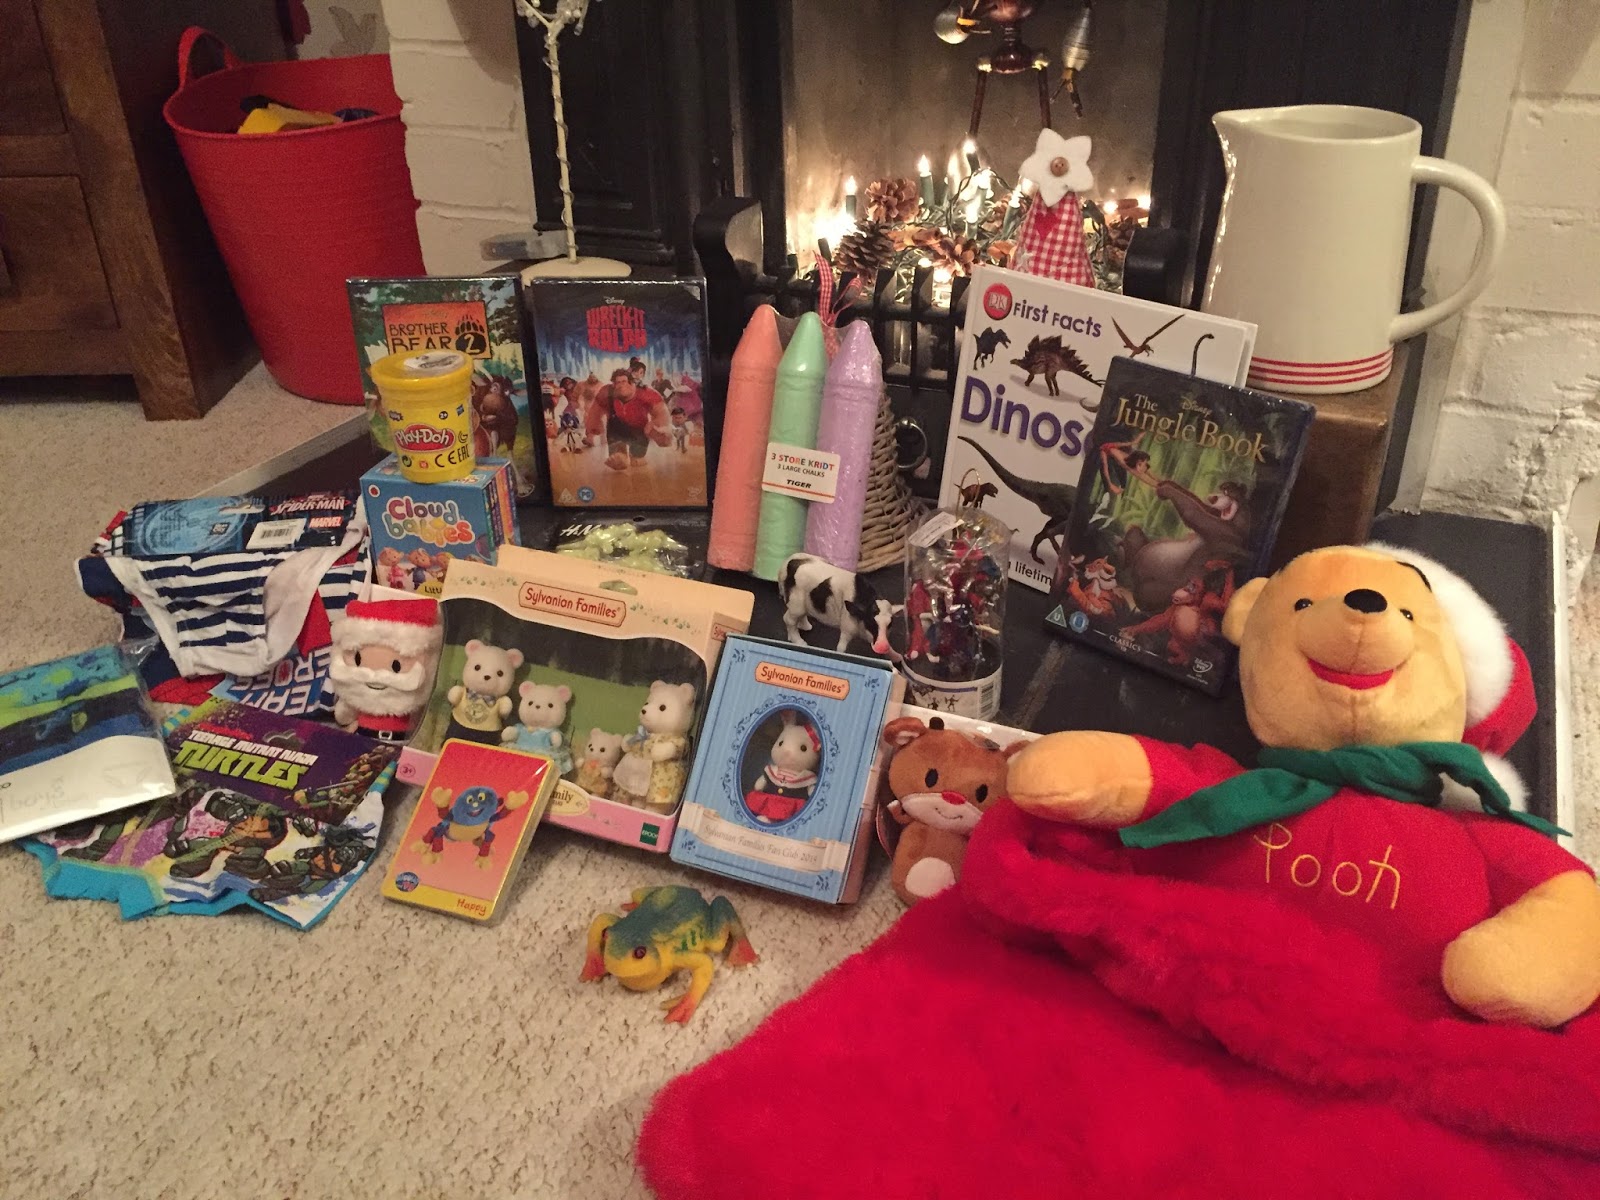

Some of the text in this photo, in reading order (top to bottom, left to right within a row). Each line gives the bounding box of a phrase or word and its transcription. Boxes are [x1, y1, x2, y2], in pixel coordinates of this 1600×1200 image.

[988, 292, 1009, 311] DK
[586, 305, 646, 328] WRECK-IT
[1013, 299, 1102, 338] First Facts
[389, 322, 449, 337] BROTHER
[464, 333, 481, 354] 2
[587, 328, 648, 353] RALPH
[1134, 393, 1159, 412] The
[395, 428, 450, 446] Play-Doh
[1110, 397, 1269, 464] Jungle Book
[771, 453, 835, 471] 3 STORE KRIDT
[782, 465, 801, 474] LARGE
[802, 468, 825, 478] CHALKS
[786, 479, 812, 489] TIGER
[270, 497, 345, 516] SPIDER-MAN
[387, 496, 459, 526] Cloud
[309, 516, 343, 529] MARVEL
[382, 512, 476, 548] babies
[1014, 561, 1052, 586] lifetim
[424, 585, 442, 595] Littl
[525, 587, 617, 619] Sylvanian Families
[1109, 634, 1142, 652] CLASSICS
[230, 646, 332, 692] EROES
[761, 666, 842, 694] Sylvanian Families
[173, 740, 310, 791] TURTLES
[767, 844, 781, 856] Fan
[783, 848, 799, 860] Club
[1253, 822, 1401, 910] Pooh
[456, 898, 487, 917] Happy
